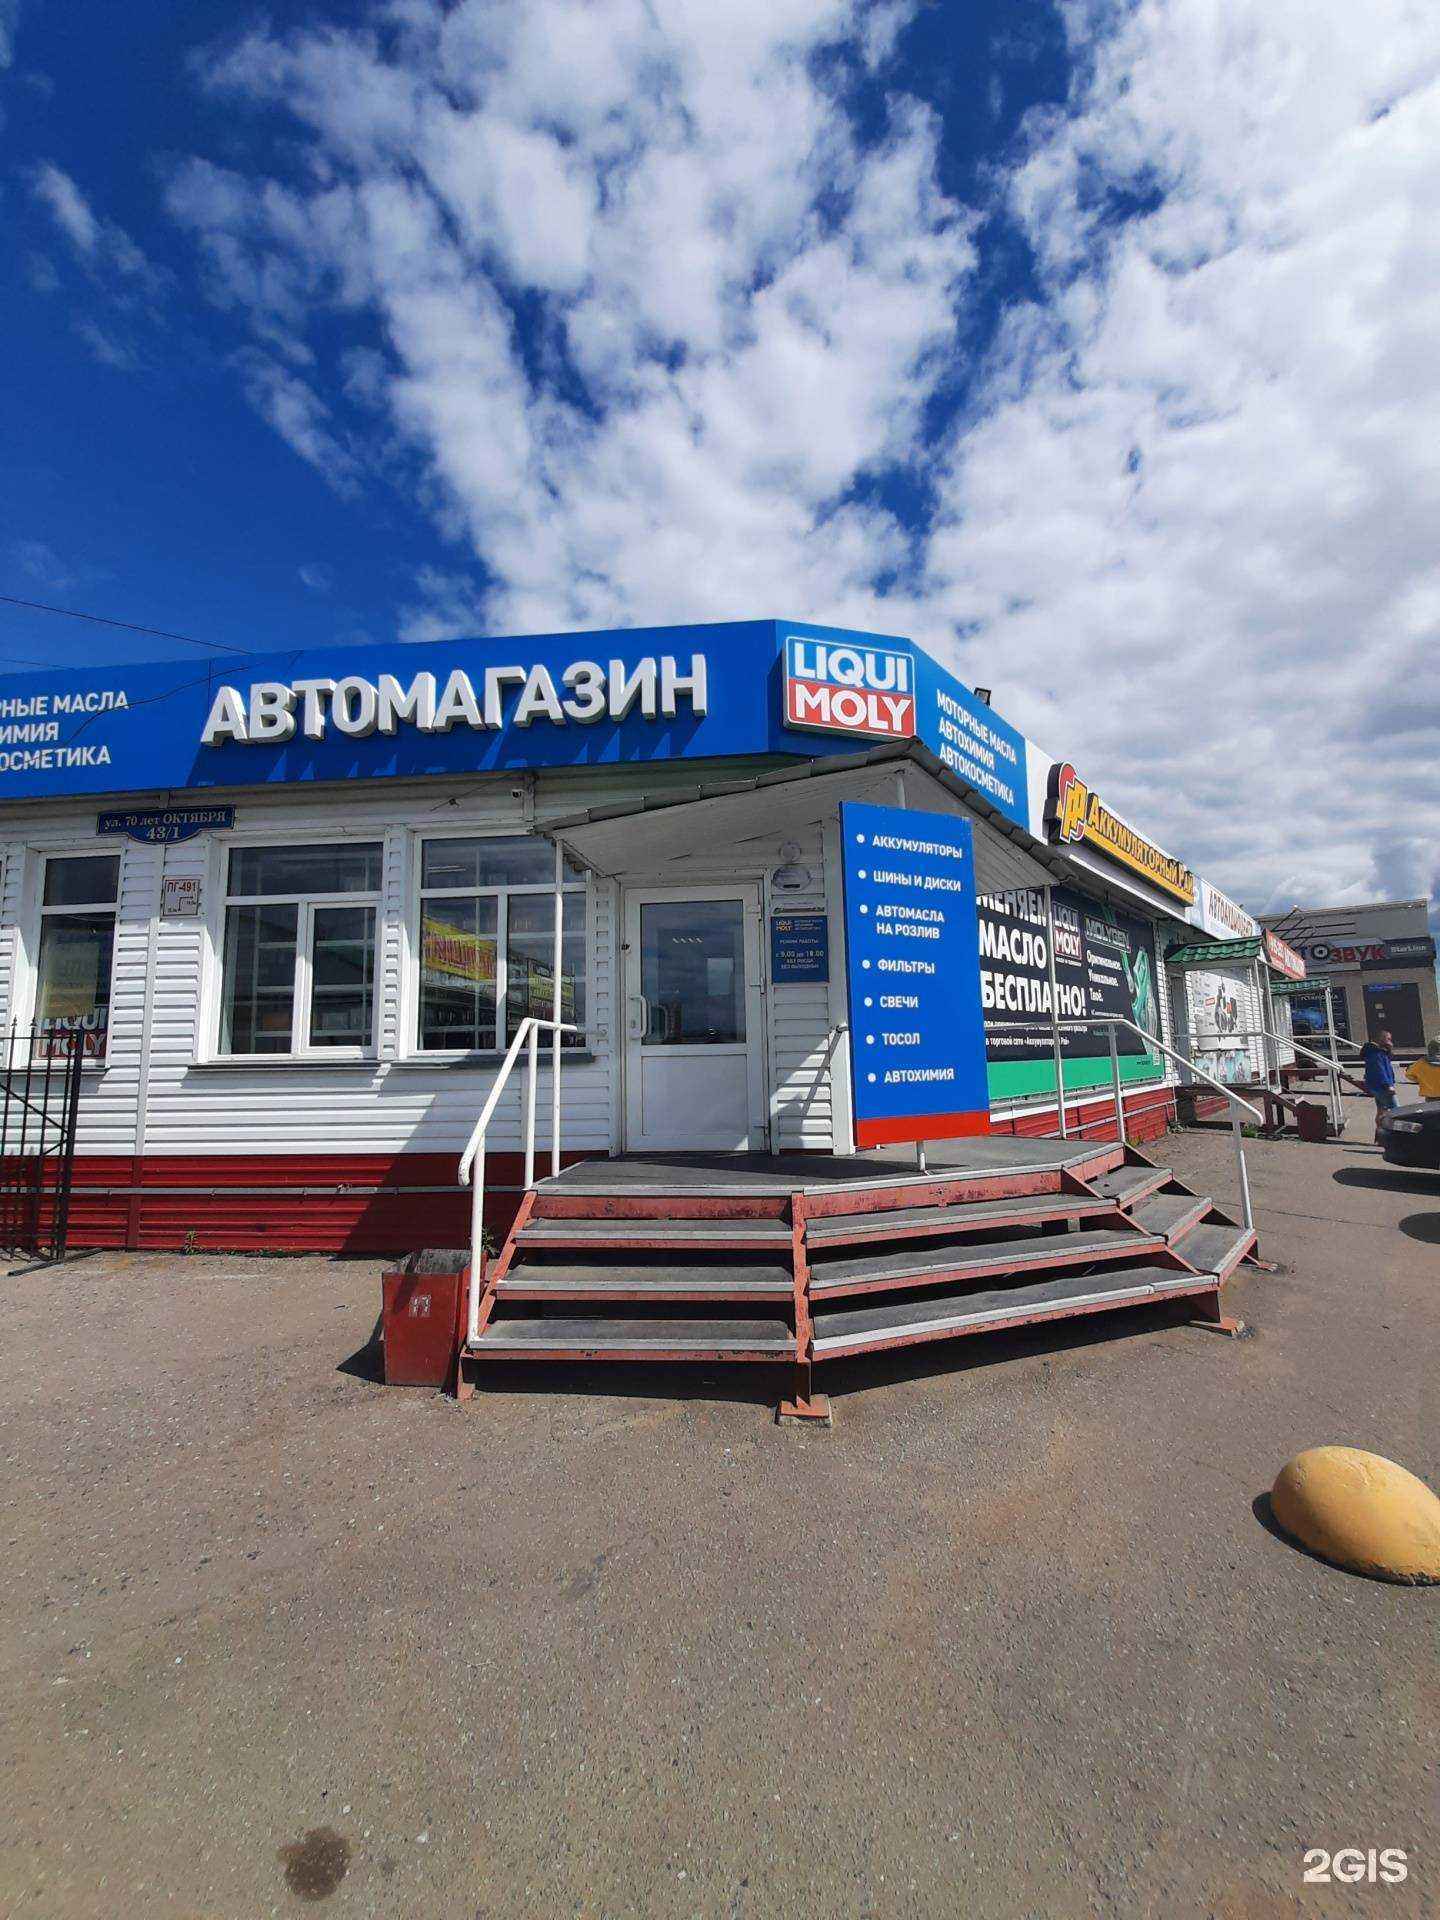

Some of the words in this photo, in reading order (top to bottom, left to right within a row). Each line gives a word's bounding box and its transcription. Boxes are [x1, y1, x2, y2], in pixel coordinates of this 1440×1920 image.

[794, 643, 908, 691] LIQUI
[0, 696, 49, 718] НЫЕ
[53, 690, 130, 714] МАСЛА
[200, 654, 707, 747] АВТОМАГАЗИН
[795, 683, 911, 732] MOLY
[937, 688, 989, 744] МОТОРНЫЕ
[989, 730, 1017, 766] МАСЛА
[939, 716, 995, 771] АВТОХИМИЯ
[940, 742, 1015, 807] АВТОКОСМЕТИКА
[104, 819, 121, 830] ул.
[125, 815, 138, 826] 70
[140, 816, 160, 826] лет
[163, 811, 226, 825] ОКТЯБРЯ
[872, 834, 963, 859] АККУМУЛЯТОРЫ
[167, 881, 197, 893] ПГ-491
[873, 870, 912, 887] ШИНЫ
[914, 875, 922, 888] И
[923, 877, 961, 892] ДИСКИ
[875, 905, 945, 923] АВТОМАСЛА
[876, 922, 893, 936] НА
[895, 923, 940, 939] РОЗЛИВ
[1056, 929, 1080, 956] MOLY
[979, 919, 1047, 969] МАСЛО
[877, 958, 936, 974] ФИЛЬТРЫ
[879, 996, 919, 1008] СВЕЧИ
[980, 970, 1087, 1016] БЕСПЛАТНО!
[882, 1032, 920, 1045] ТОСОЛ
[884, 1068, 954, 1083] АВТОХИМИЯ
